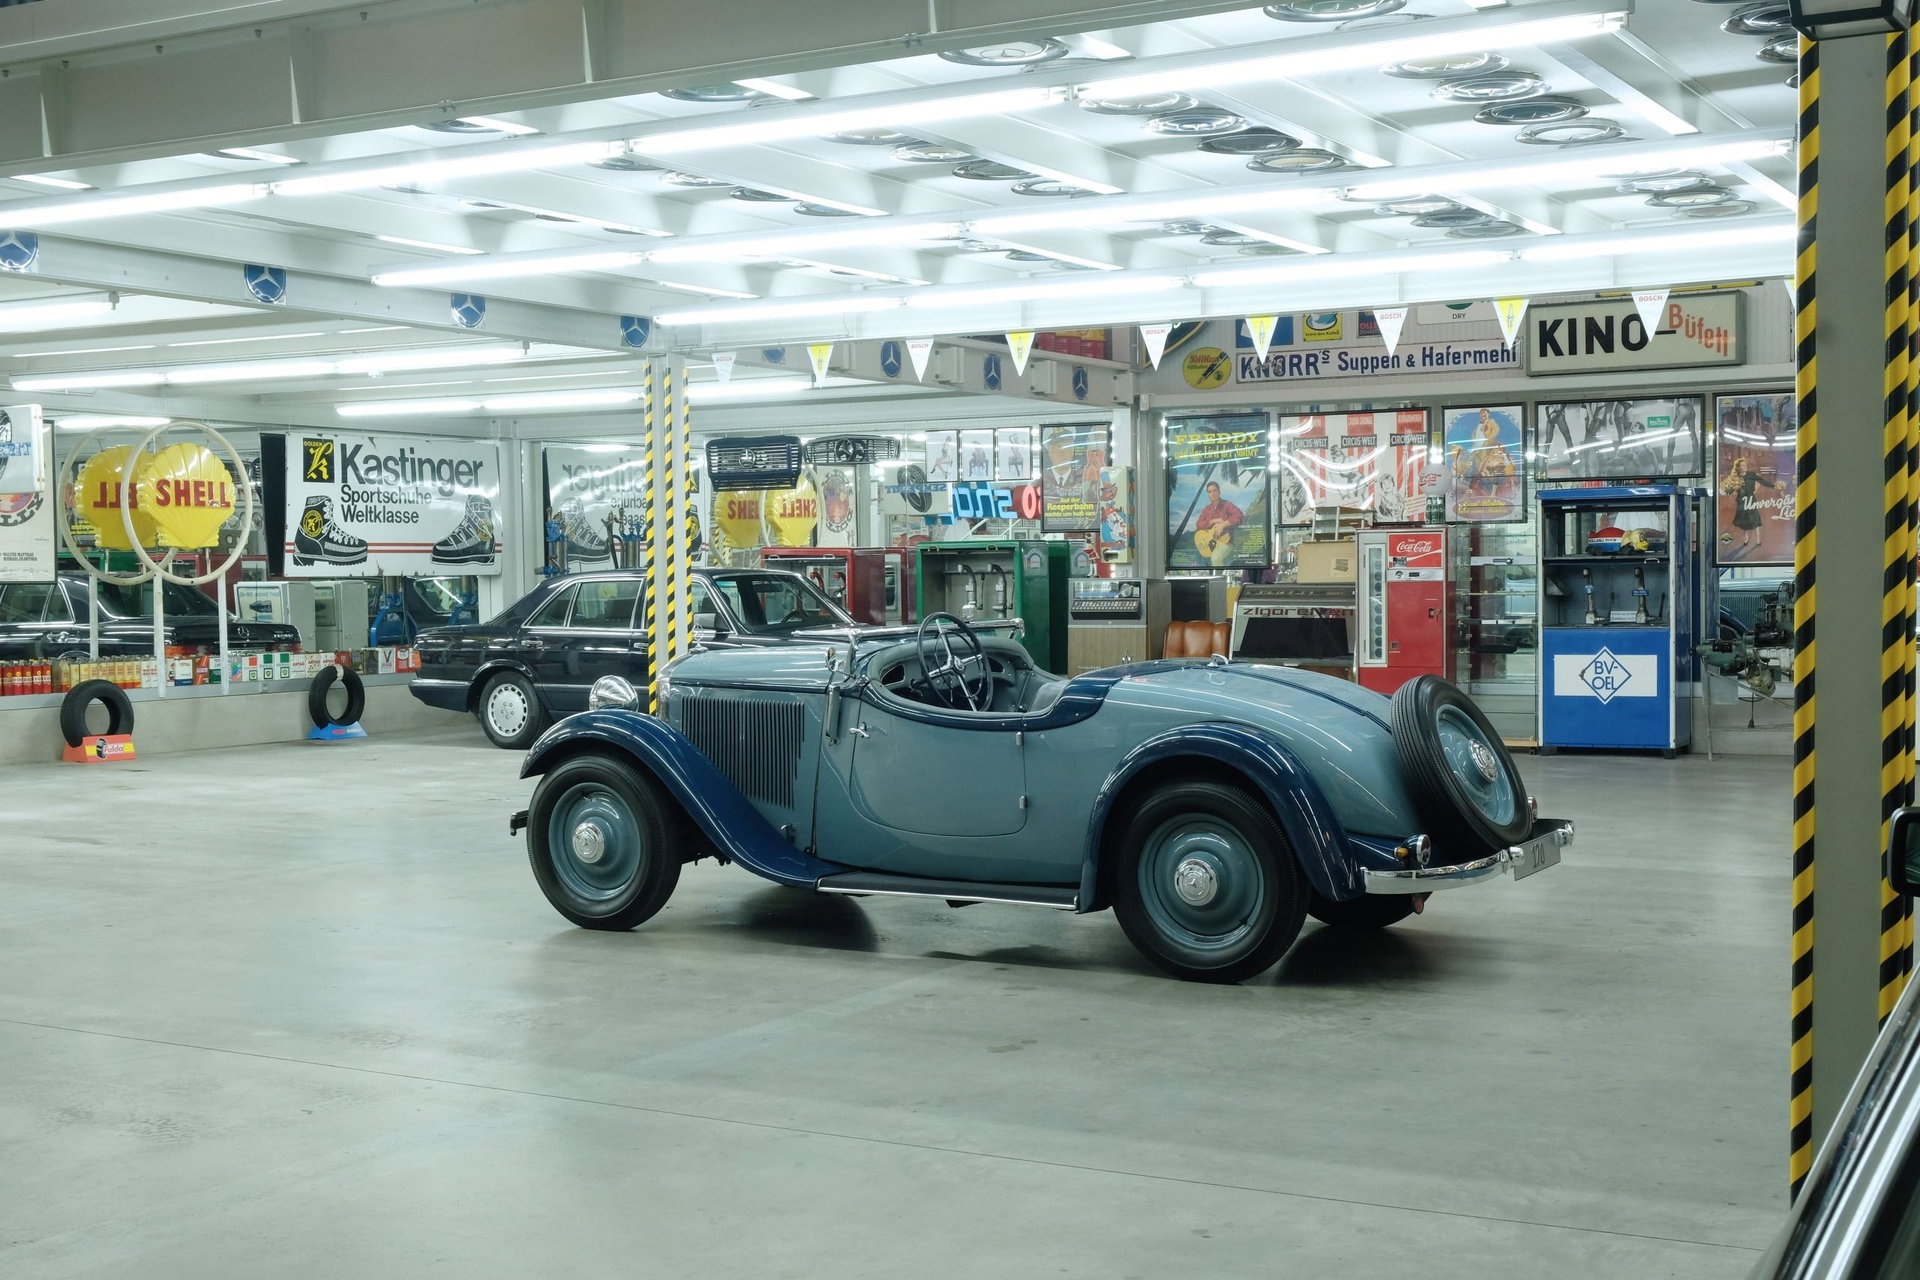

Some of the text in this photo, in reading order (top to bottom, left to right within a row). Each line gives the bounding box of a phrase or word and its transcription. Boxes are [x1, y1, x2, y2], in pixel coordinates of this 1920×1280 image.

[1638, 294, 1663, 302] BOSCH
[1669, 303, 1729, 357] Büfett
[1337, 351, 1400, 374] Suppen
[1405, 353, 1416, 368] &
[1421, 342, 1517, 367] Hafermehl
[1175, 431, 1260, 446] FREDDY
[1294, 438, 1327, 448] CIRCUS-WELT
[1342, 436, 1376, 446] CIRCUS-WELT
[1391, 434, 1426, 445] CIRCUS-WELT
[340, 443, 483, 497] Kastinger
[155, 479, 231, 508] SHELL
[341, 484, 432, 504] Sportschuhe
[341, 505, 419, 524] Weltklasse
[1047, 503, 1094, 512] Reeperbahn
[1592, 676, 1617, 690] OEL
[104, 744, 123, 753] Fulda
